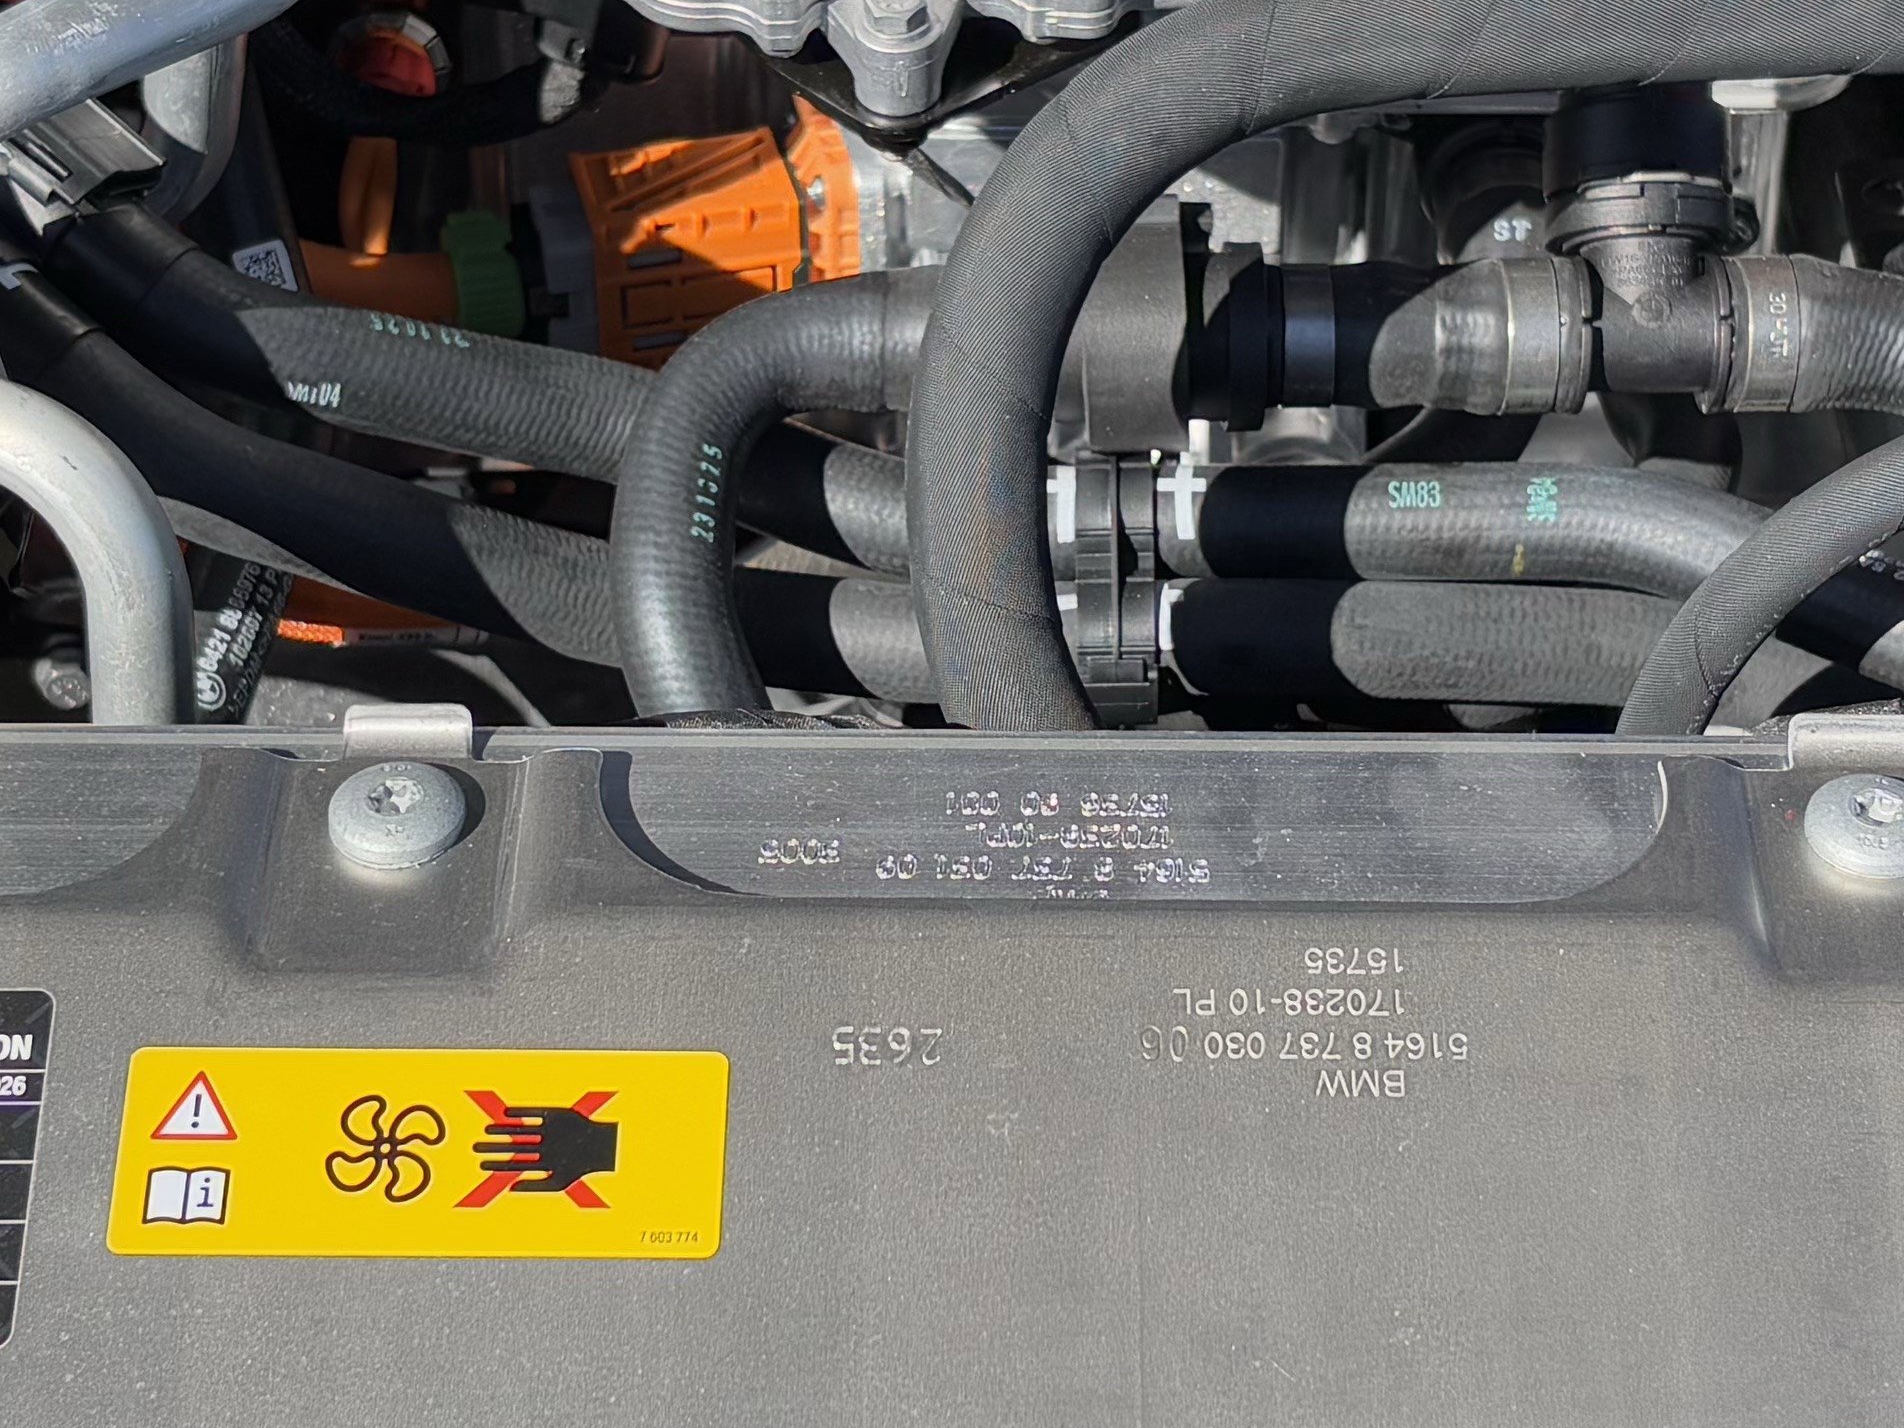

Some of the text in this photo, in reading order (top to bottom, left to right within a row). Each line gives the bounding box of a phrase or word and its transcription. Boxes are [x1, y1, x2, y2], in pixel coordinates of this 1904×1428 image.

[1387, 480, 1442, 510] SM83
[1304, 947, 1404, 975] 15735
[1172, 989, 1405, 1017] 170238-10 PL
[831, 1025, 943, 1067] 2635
[1141, 1026, 1468, 1063] 5164 8 737 030 06
[1315, 1069, 1405, 1099] BMW
